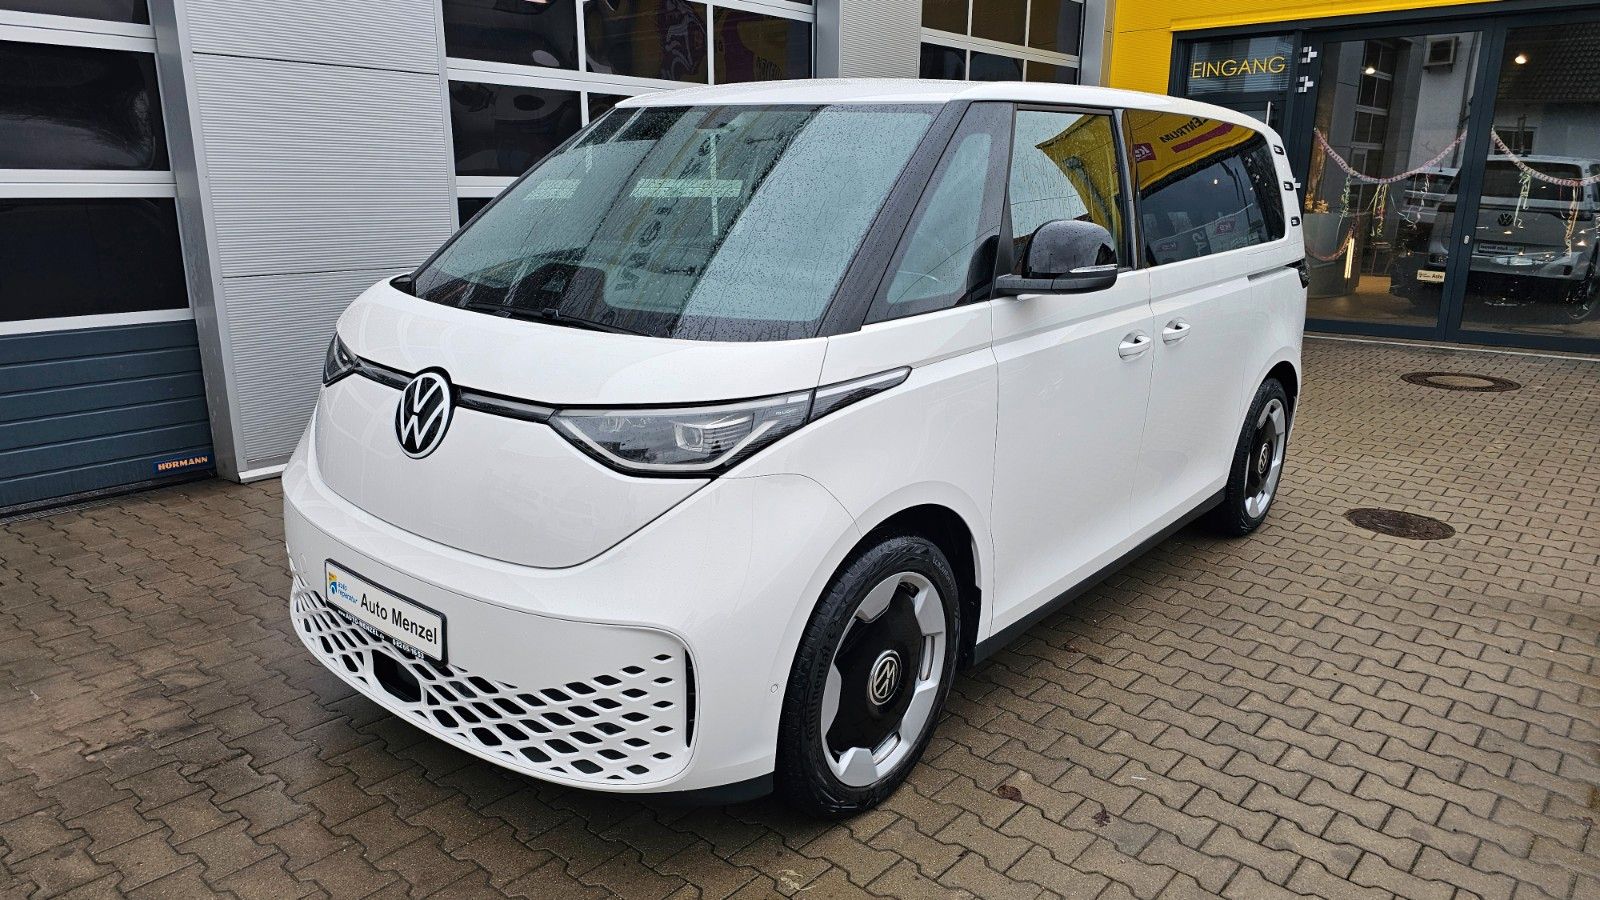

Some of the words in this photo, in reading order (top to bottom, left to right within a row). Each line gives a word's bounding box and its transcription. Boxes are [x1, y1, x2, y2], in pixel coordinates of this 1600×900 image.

[1192, 56, 1286, 78] EINGANG
[360, 593, 388, 620] Auto
[391, 608, 437, 645] Menzel
